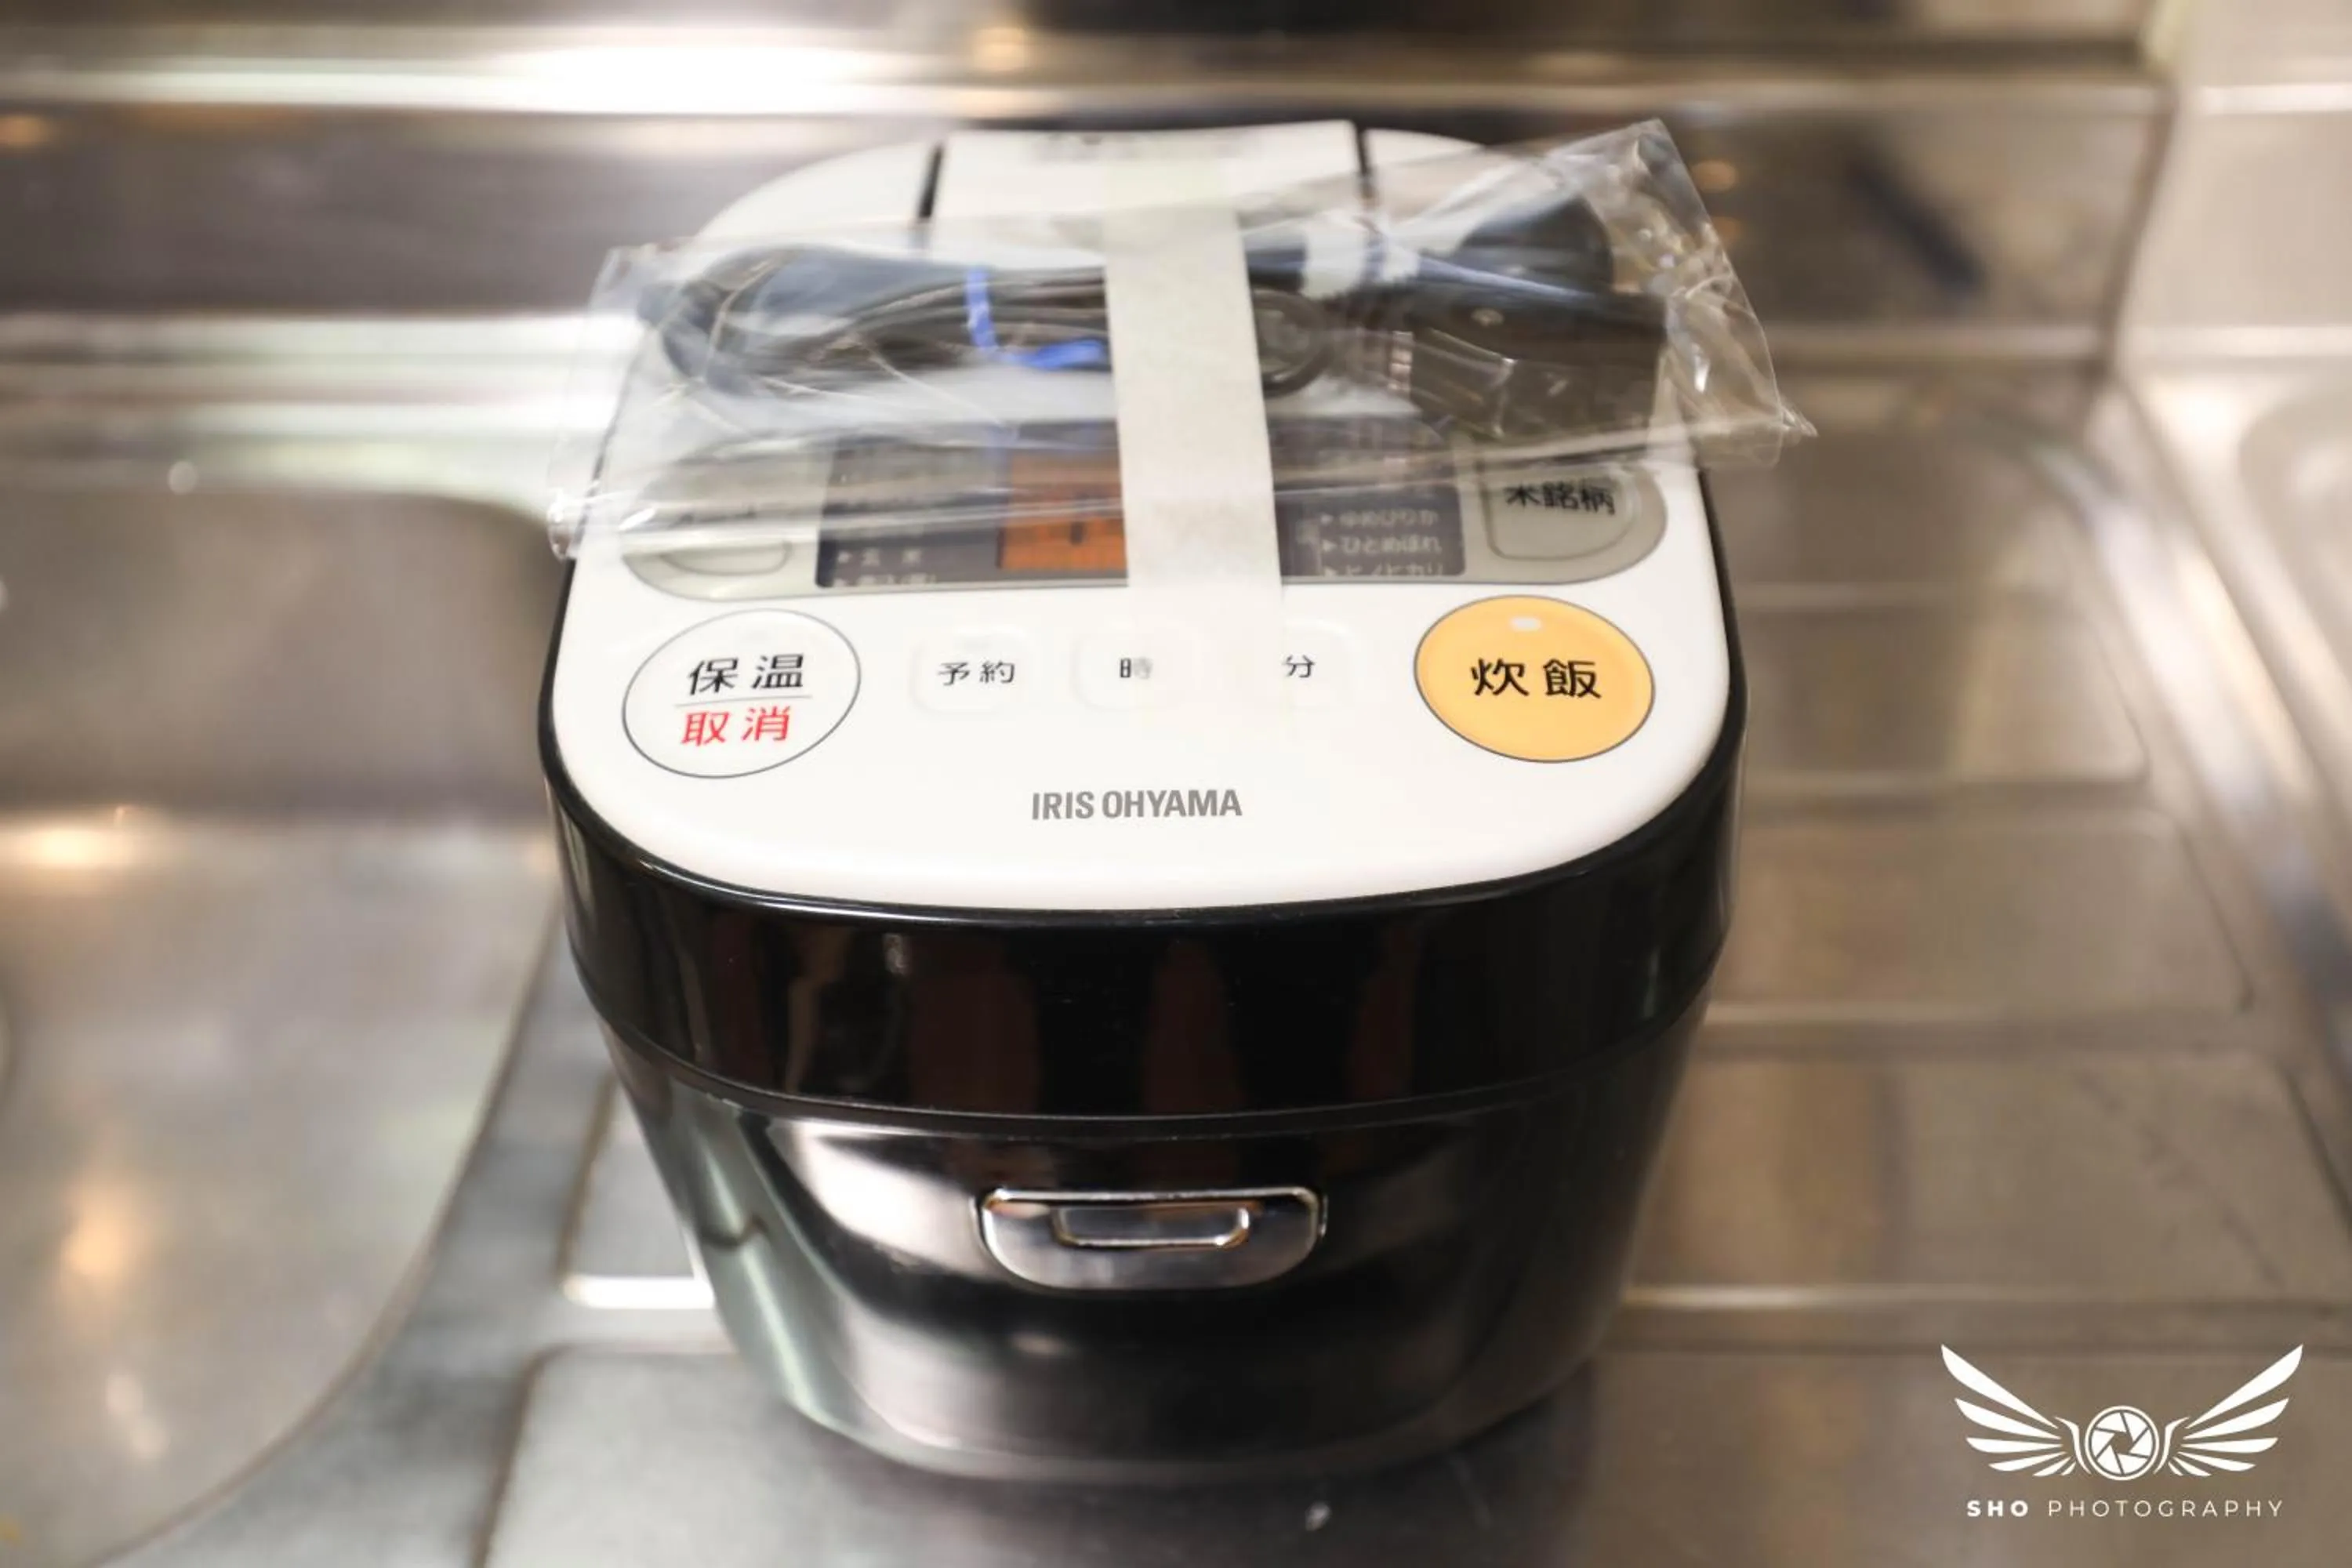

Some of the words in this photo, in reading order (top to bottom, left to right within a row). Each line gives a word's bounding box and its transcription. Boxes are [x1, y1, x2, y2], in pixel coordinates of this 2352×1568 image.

[690, 655, 804, 695] 保温
[938, 661, 1016, 686] 予約
[1283, 655, 1316, 678] 分
[1470, 658, 1602, 699] 炊飯
[681, 705, 790, 746] 取消
[1032, 791, 1094, 820] IRIS
[1102, 789, 1243, 818] OHYAMA
